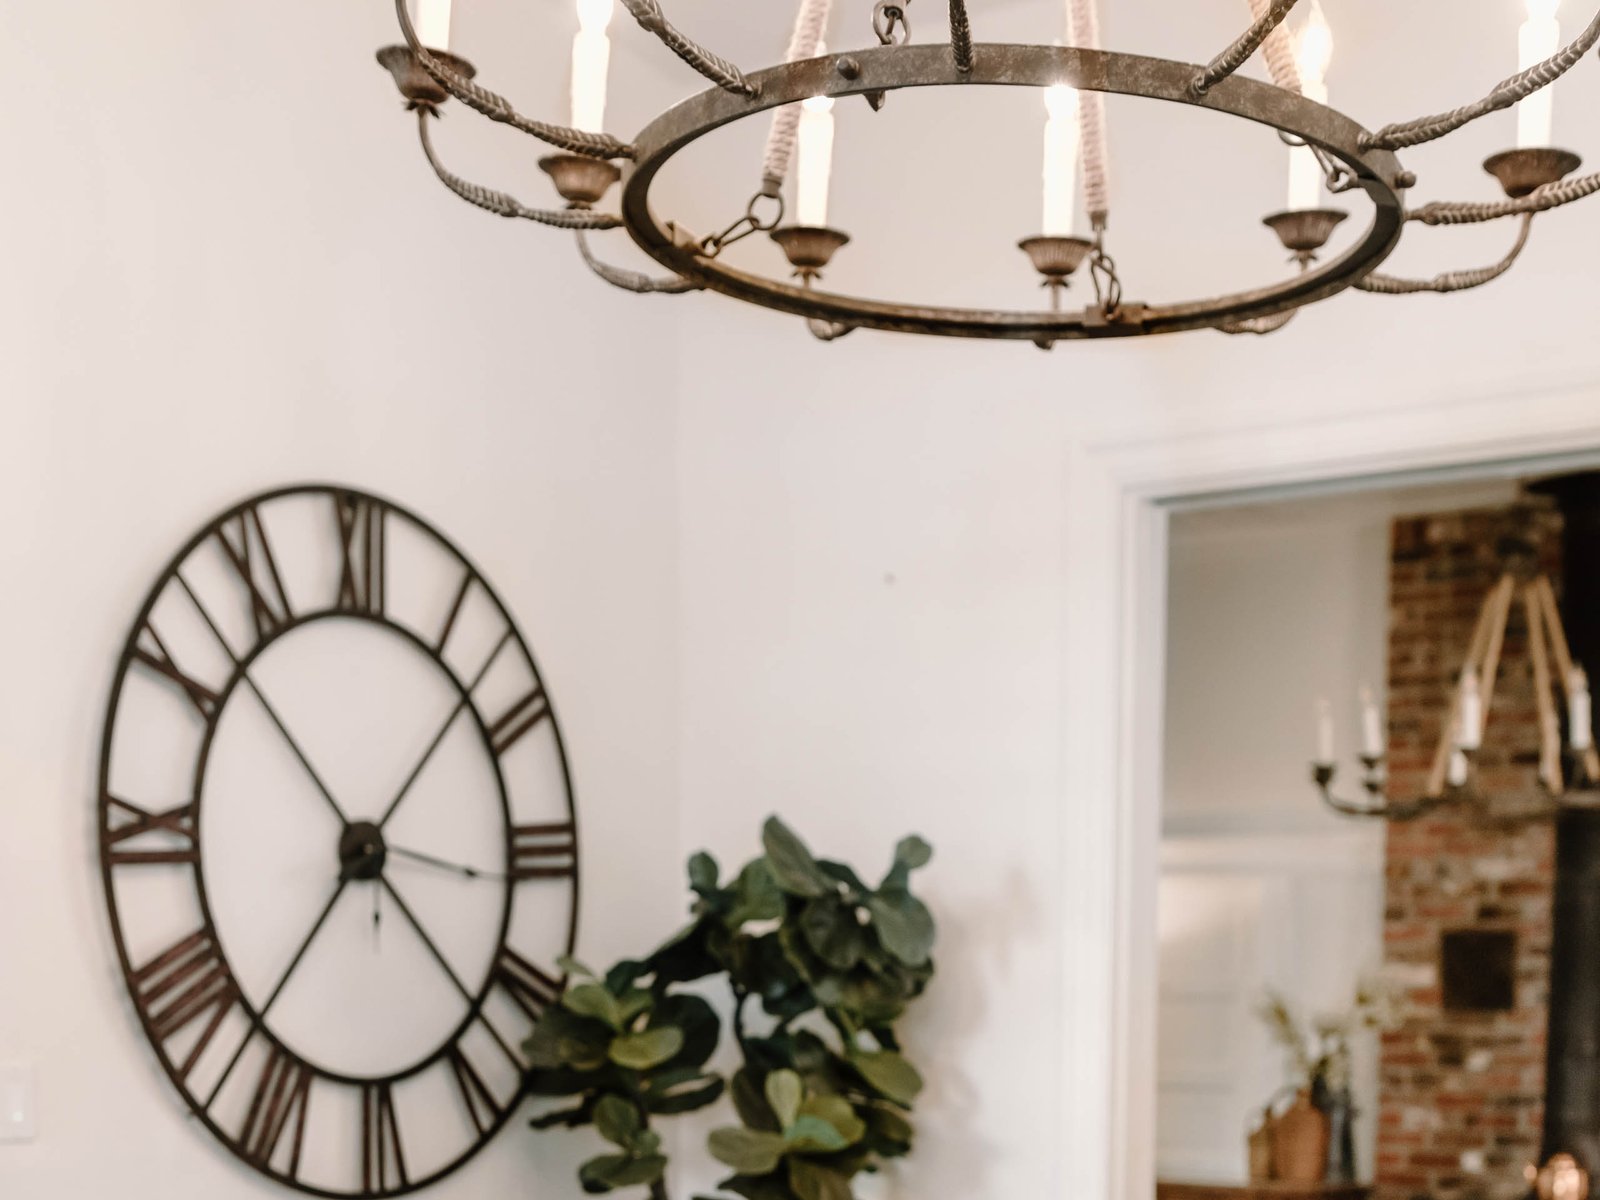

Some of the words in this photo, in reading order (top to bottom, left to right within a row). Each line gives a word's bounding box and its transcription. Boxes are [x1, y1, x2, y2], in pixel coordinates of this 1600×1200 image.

[212, 502, 292, 640] XI
[333, 488, 387, 616] XII
[487, 687, 551, 754] II
[103, 795, 201, 863] IX
[508, 823, 577, 881] III
